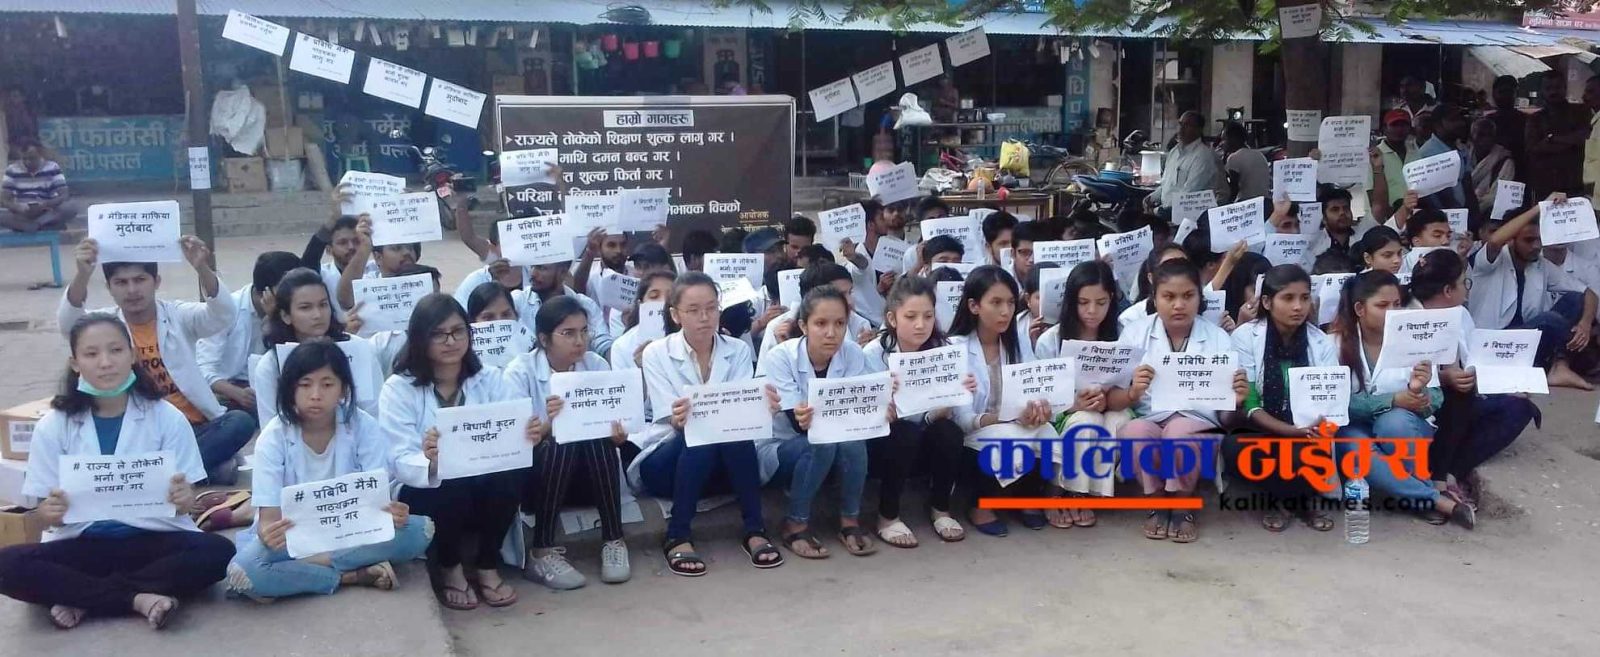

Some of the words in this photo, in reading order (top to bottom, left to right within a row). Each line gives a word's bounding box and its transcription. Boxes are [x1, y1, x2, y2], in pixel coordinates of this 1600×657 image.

[515, 131, 557, 145] राज्यले
[563, 131, 602, 144] तोकेको
[606, 132, 641, 144] शिक्षण
[647, 132, 674, 144] शुल्क
[680, 132, 704, 144] लागु
[708, 132, 724, 142] गर
[592, 152, 620, 162] दमन
[625, 152, 648, 162] बन्द
[653, 152, 670, 161] गर
[579, 169, 608, 182] शुल्क
[614, 168, 642, 181] फिर्ता
[646, 170, 663, 180] गर
[141, 211, 170, 220] माफिया
[116, 222, 153, 236] मुर्दाबाद
[518, 219, 542, 230] प्रबिधि
[547, 217, 562, 225] मैत्री
[524, 242, 538, 252] लागु
[1412, 331, 1434, 340] पाइदैन
[929, 354, 944, 363] सेतो
[948, 350, 960, 360] कोट
[1077, 354, 1109, 363] मानसिक
[1177, 355, 1206, 365] प्रबिधि
[1211, 355, 1229, 365] मैत्री
[920, 364, 938, 374] कालो
[942, 363, 956, 371] दाग
[1045, 363, 1067, 373] तोकेको
[1177, 370, 1213, 378] पाठ्यक्रम
[905, 376, 931, 387] लगाउन
[935, 373, 959, 383] पाइदैन
[1038, 375, 1054, 386] शुल्क
[850, 384, 866, 394] सेतो
[870, 383, 885, 393] कोट
[1044, 385, 1054, 393] गर
[1178, 381, 1194, 391] लागु
[575, 388, 604, 398] सिनियर
[839, 396, 858, 405] कालो
[822, 408, 849, 418] लगाउन
[853, 405, 878, 415] पाइदैन
[471, 431, 498, 442] पाइदैन
[86, 462, 110, 471] राज्य
[117, 460, 125, 469] ले
[131, 456, 164, 469] तोकेको
[120, 471, 145, 485] शुल्क
[94, 484, 124, 493] कायम
[313, 482, 348, 499] प्रबिधि
[355, 477, 379, 490] मैत्री
[316, 497, 359, 514] पाठ्यक्रम
[319, 515, 342, 528] लागु
[345, 511, 359, 520] गर
